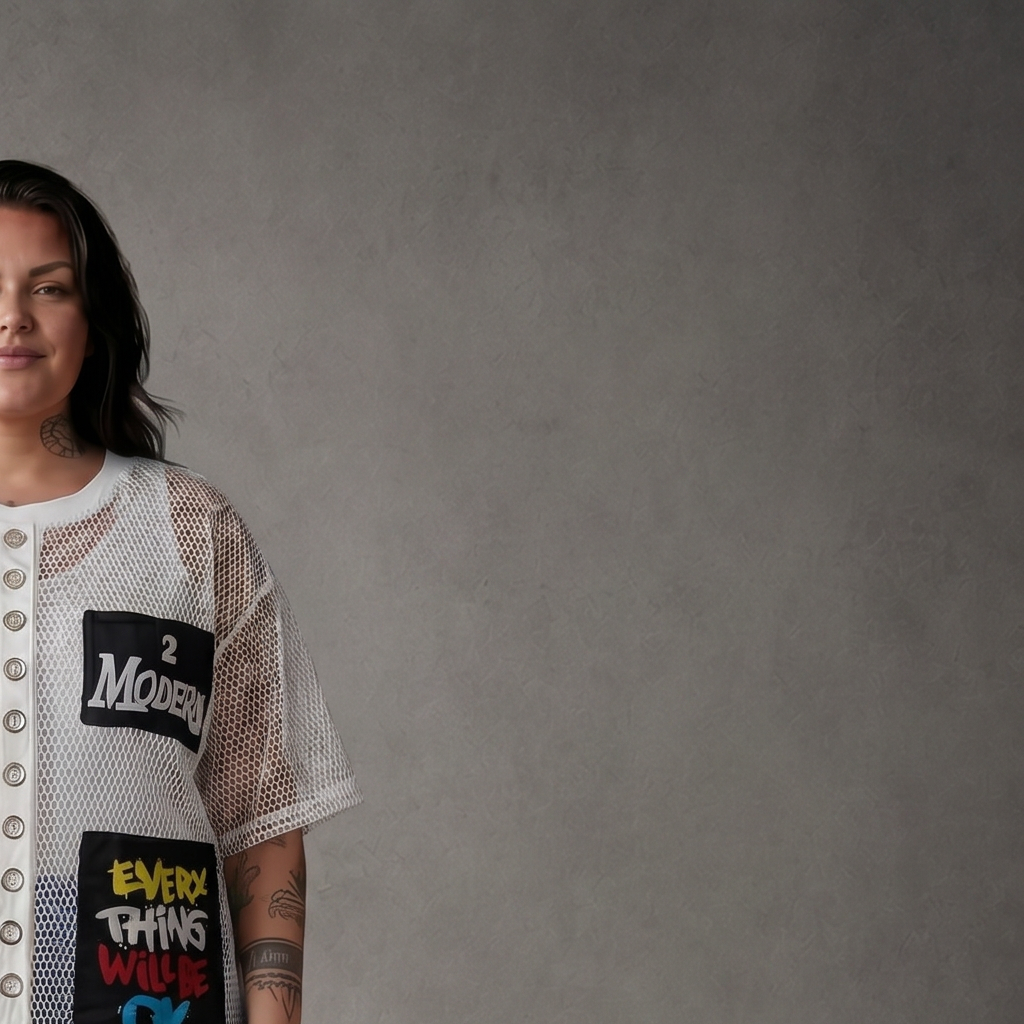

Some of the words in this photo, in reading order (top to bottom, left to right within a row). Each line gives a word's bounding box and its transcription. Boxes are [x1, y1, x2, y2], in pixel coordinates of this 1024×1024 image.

[161, 634, 178, 665] 2
[107, 859, 208, 904] EVERY
[178, 954, 209, 999] BE
